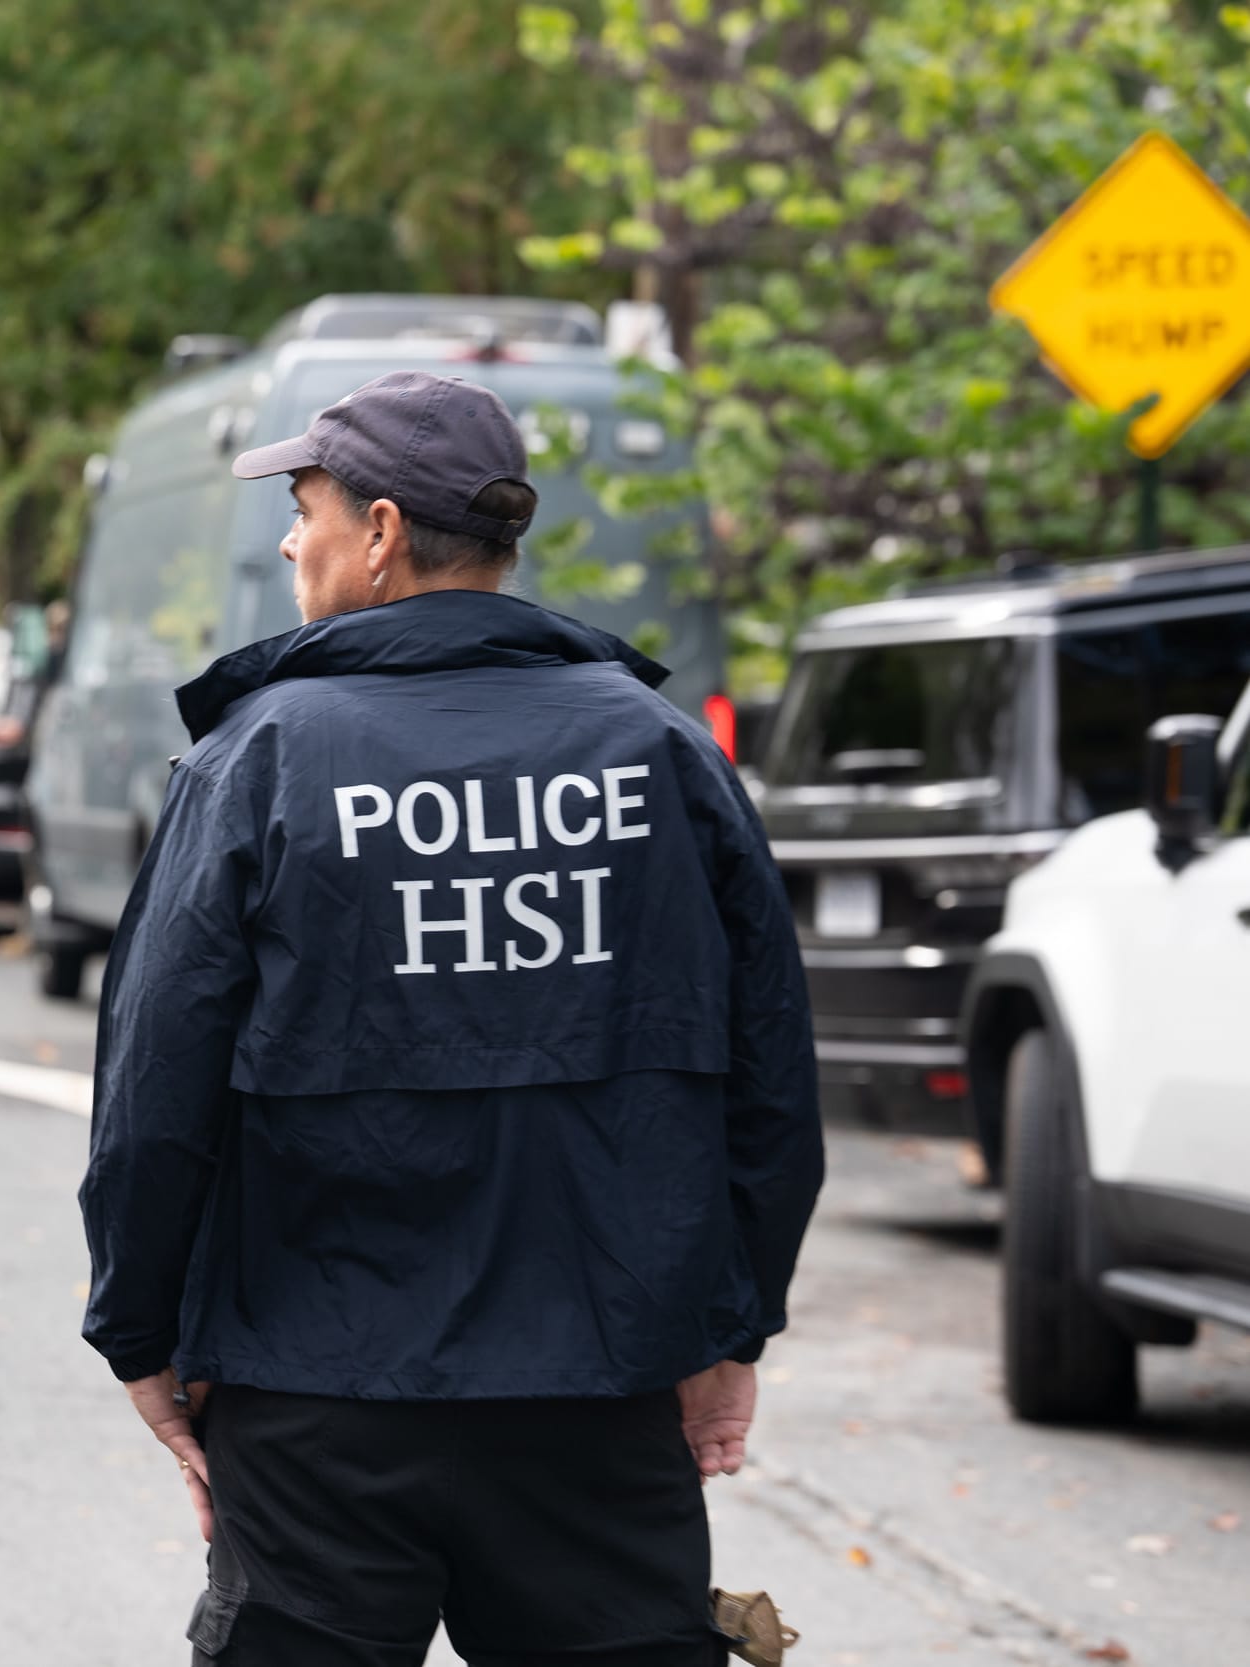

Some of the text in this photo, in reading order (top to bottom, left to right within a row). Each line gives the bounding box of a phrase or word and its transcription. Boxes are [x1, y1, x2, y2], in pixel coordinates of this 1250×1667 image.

[1085, 244, 1234, 287] SPEED
[1087, 315, 1225, 353] HUMP
[334, 764, 651, 858] POLICE
[392, 867, 613, 974] HSI
